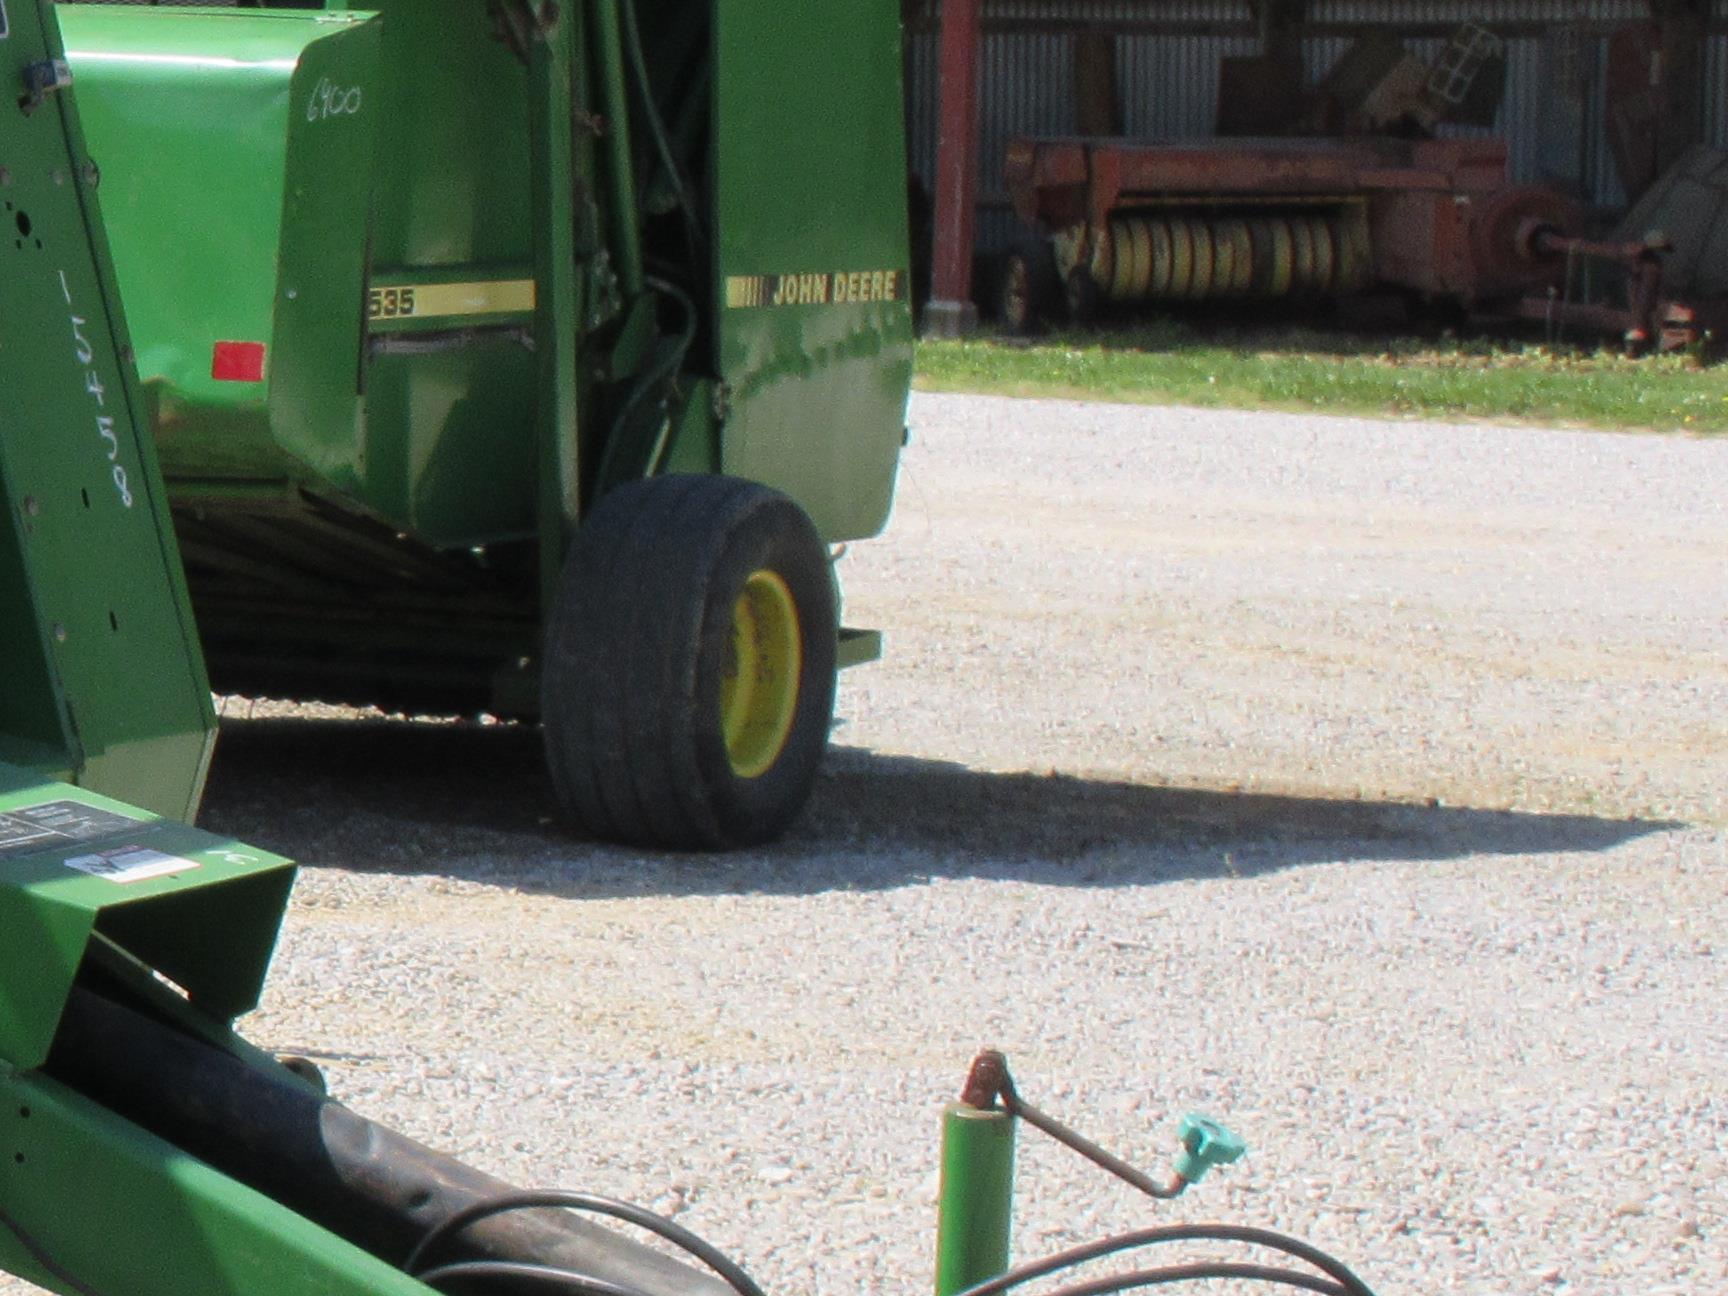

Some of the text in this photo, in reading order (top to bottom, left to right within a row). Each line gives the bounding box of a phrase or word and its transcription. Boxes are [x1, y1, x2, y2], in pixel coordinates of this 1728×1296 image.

[368, 288, 415, 316] 535
[774, 270, 897, 305] JOHN DEERE
